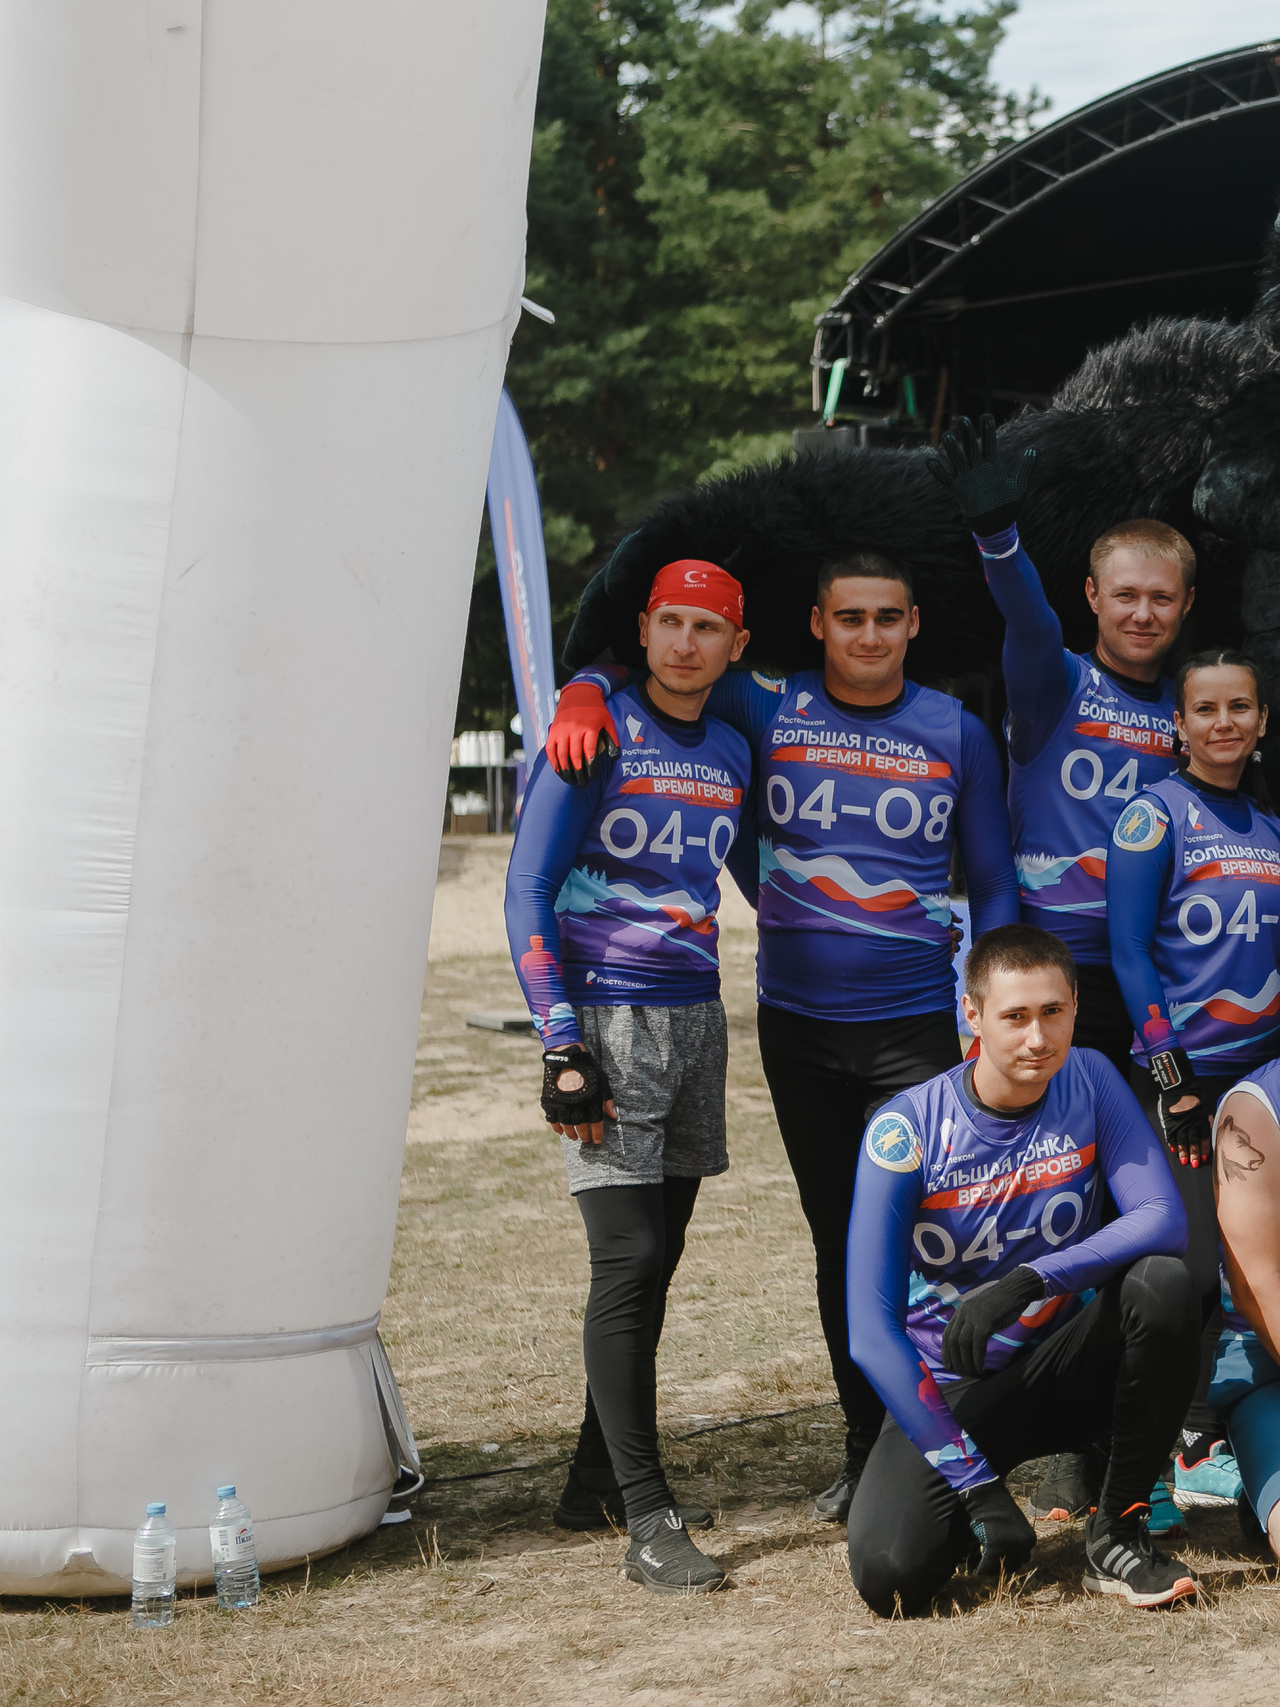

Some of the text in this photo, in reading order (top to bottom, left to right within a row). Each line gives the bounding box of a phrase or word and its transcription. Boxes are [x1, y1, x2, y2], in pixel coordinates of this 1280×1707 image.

[778, 714, 826, 726] Ростелеком
[1078, 700, 1178, 735] БОЛЬШАЯ ГОН
[772, 729, 928, 760] БОЛЬШАЯ ГОНКА
[1108, 724, 1151, 746] ВРЕМЯ
[621, 760, 732, 786] БОЛЬШАЯ ГОНКА
[805, 747, 930, 776] ВРЕМЯ ГЕРОЕВ
[1060, 748, 1150, 803] 04
[653, 779, 734, 803] ВРЕМЯ ГЕРОЕВ
[766, 774, 954, 843] 04-08
[600, 807, 737, 869] 04-0
[1183, 845, 1255, 867] БОЛЬШАЯ
[1220, 860, 1264, 876] ВРЕМЯ
[1016, 1134, 1078, 1165] ГОНКА
[957, 1153, 1083, 1206] ВРЕМЯ ГЕРОЕВ
